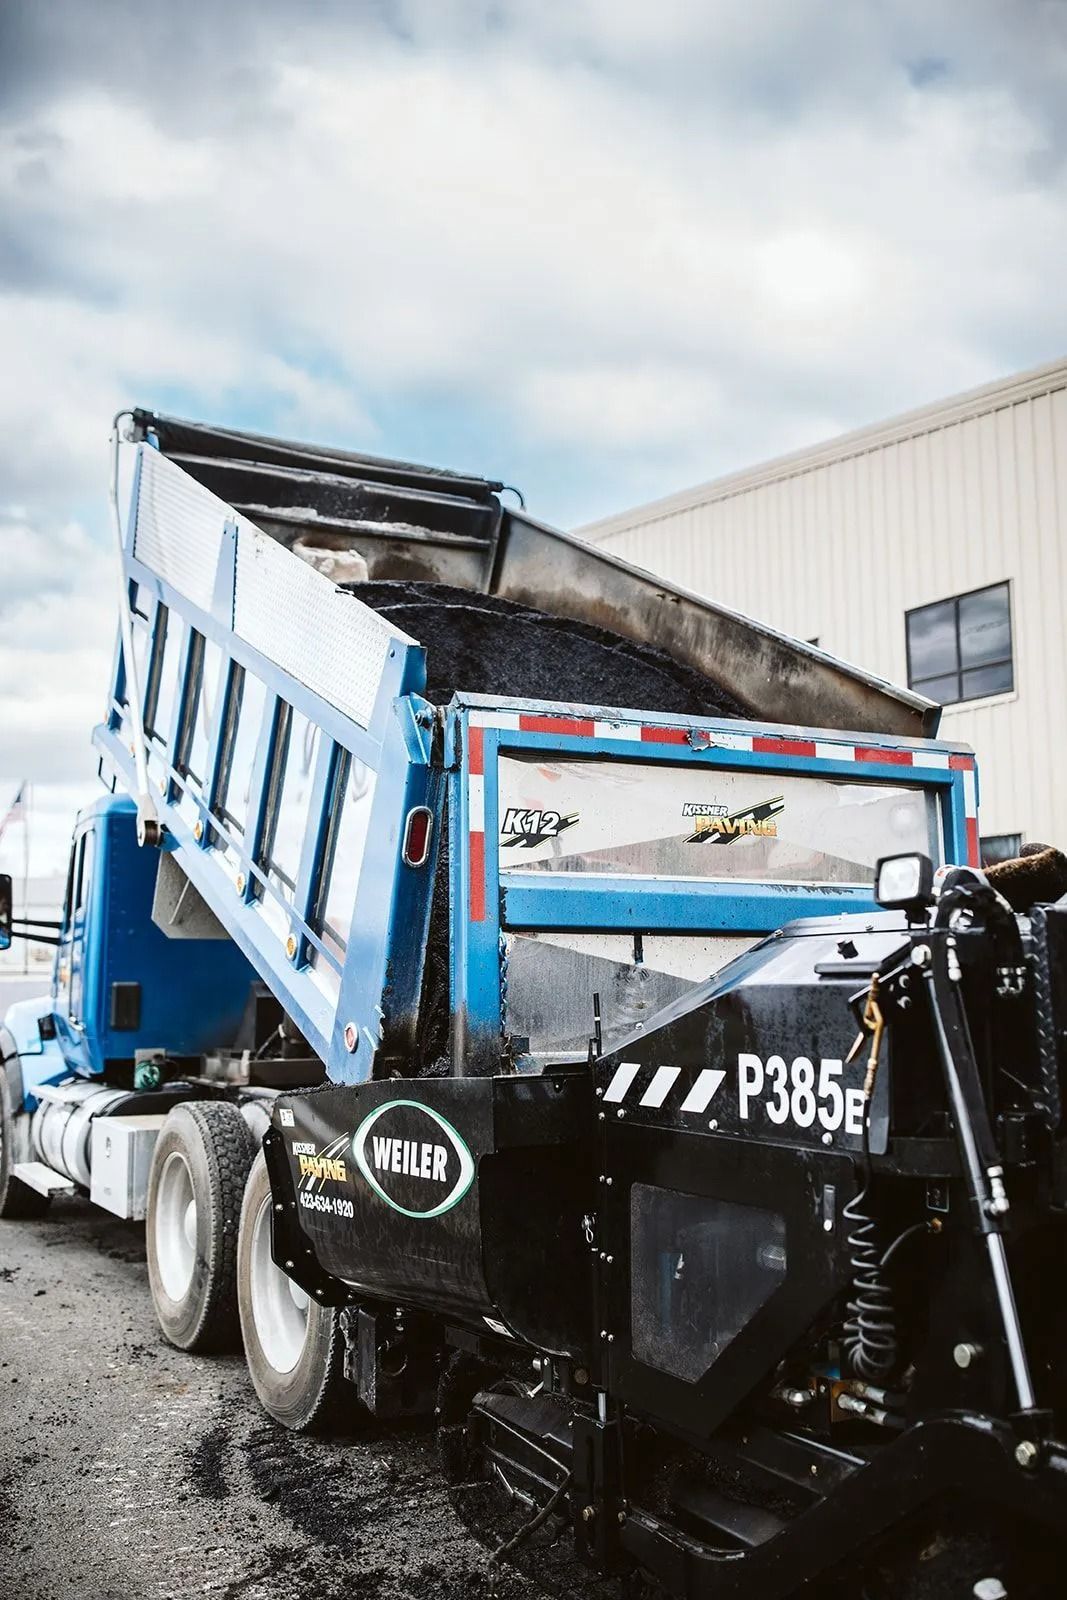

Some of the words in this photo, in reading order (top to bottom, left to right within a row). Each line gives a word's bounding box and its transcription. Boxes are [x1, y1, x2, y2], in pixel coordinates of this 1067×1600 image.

[501, 808, 561, 837] K12
[682, 803, 728, 818] KISSNER
[695, 815, 777, 837] PAVING
[298, 1154, 347, 1183] PAVING
[372, 1136, 448, 1183] WEILER
[300, 1191, 354, 1219] 423-634-1920
